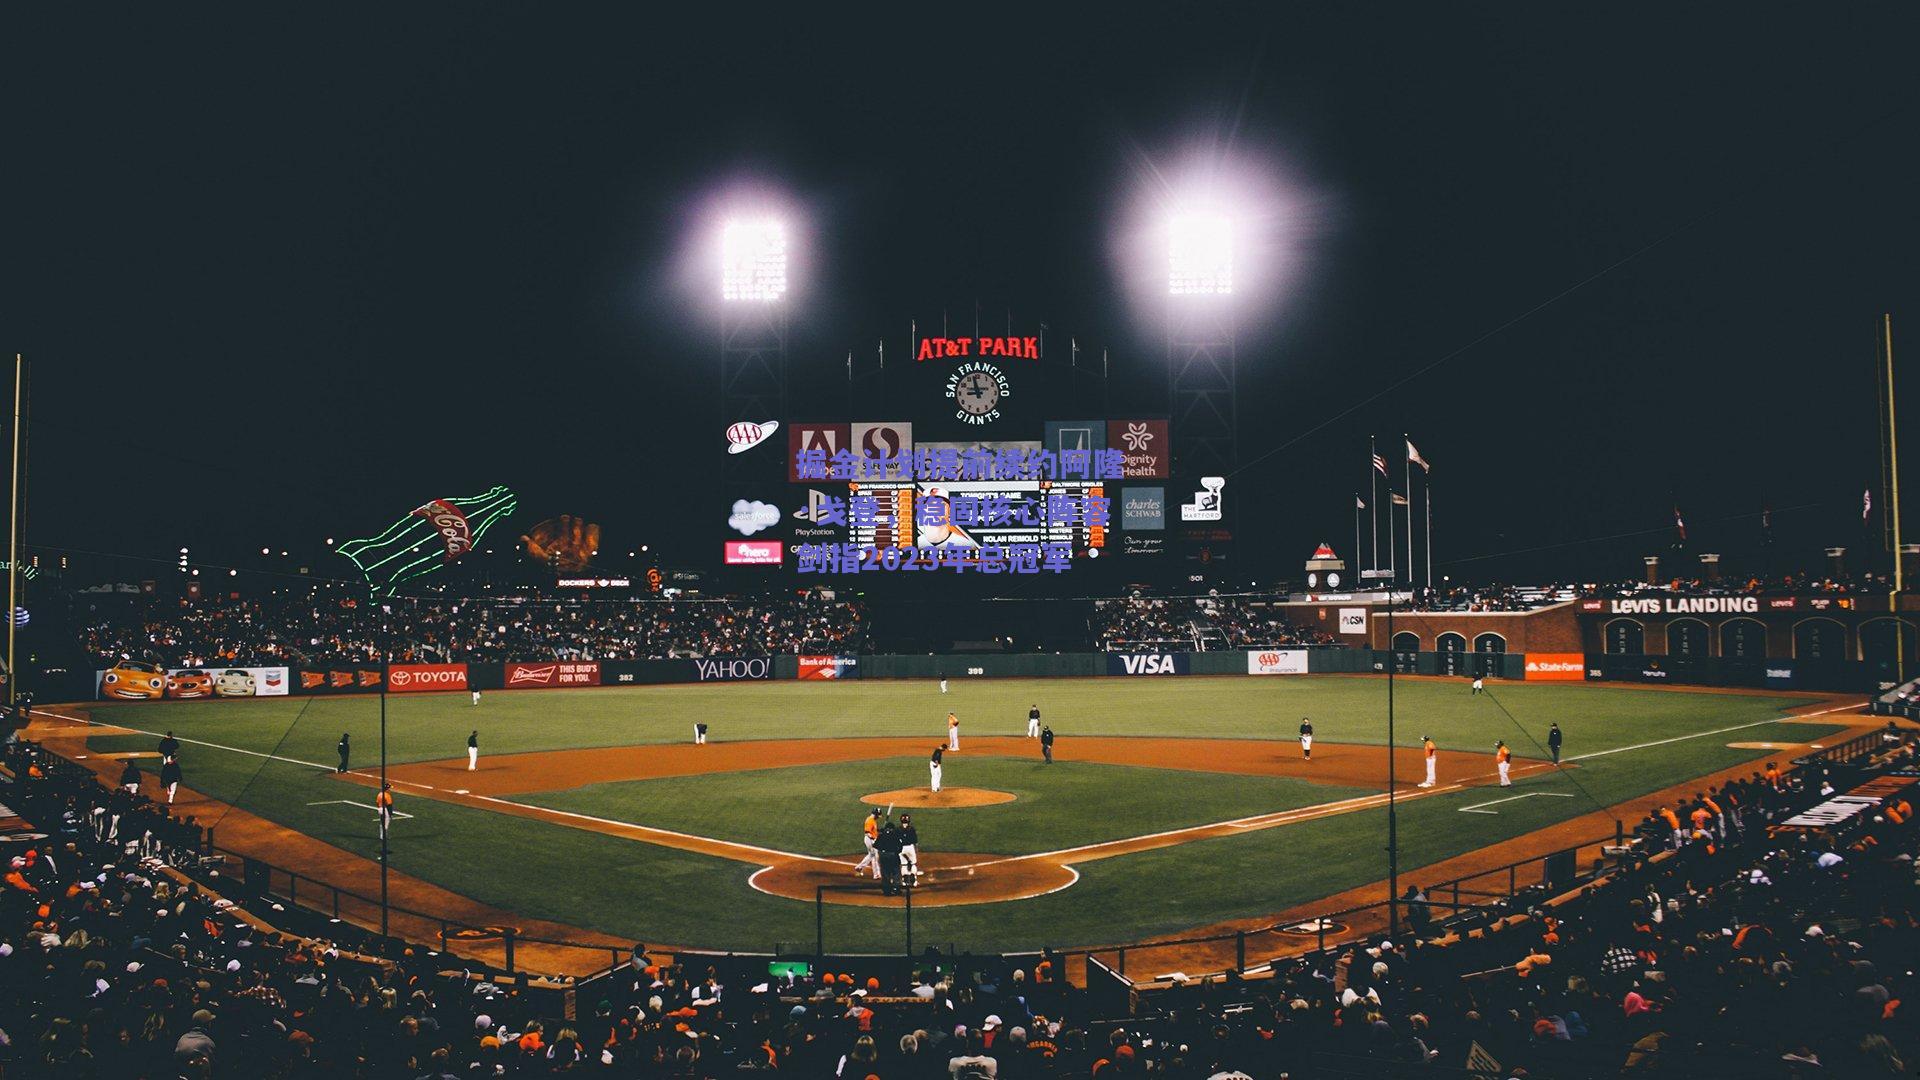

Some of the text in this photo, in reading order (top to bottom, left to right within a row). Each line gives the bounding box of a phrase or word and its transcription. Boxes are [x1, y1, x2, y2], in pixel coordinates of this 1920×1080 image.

[917, 337, 1038, 360] AT&T PARK
[946, 361, 1010, 398] SAN FRANCISCO
[956, 409, 1000, 425] GIANTS
[729, 424, 760, 444] AAA
[1119, 454, 1158, 467] Dignity
[1120, 466, 1156, 477] Health
[1125, 499, 1160, 510] charles
[734, 511, 774, 521] salesforce
[1125, 510, 1161, 518] SCHWAB
[795, 528, 835, 536] PlayStation
[983, 535, 1039, 543] NOLAN REIMOLD
[1666, 597, 1758, 613] LANDING
[1349, 616, 1364, 625] CSN
[800, 658, 856, 666] Bank of America
[1119, 654, 1176, 675] VISA
[1258, 652, 1280, 667] AAA
[559, 664, 597, 673] THIS BUD'S
[695, 658, 770, 681] YAHOO!
[412, 671, 467, 683] TOYOTA
[559, 674, 591, 682] FOR YOU.
